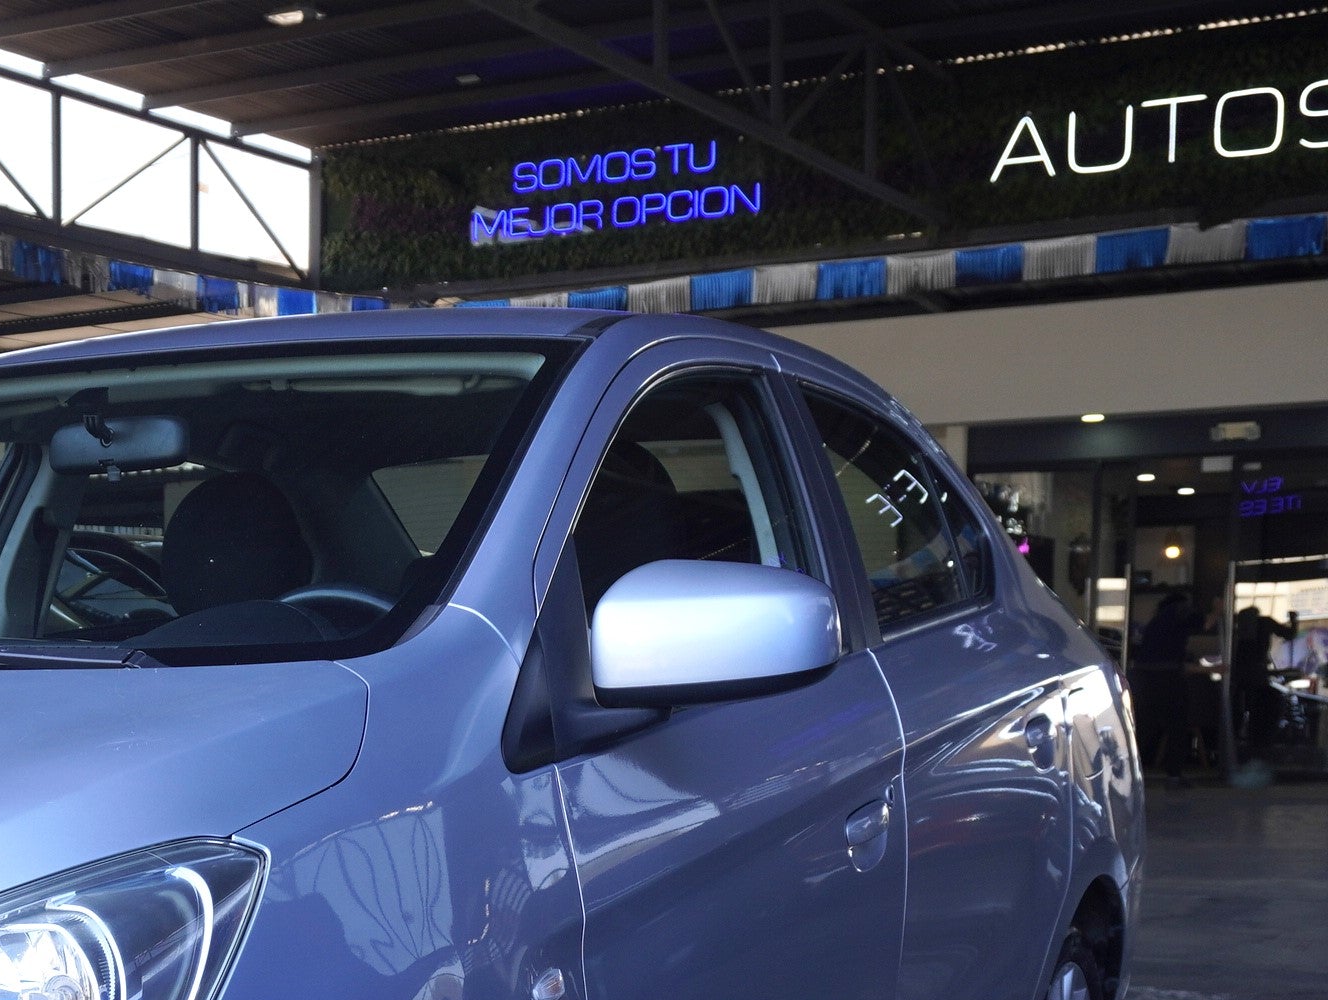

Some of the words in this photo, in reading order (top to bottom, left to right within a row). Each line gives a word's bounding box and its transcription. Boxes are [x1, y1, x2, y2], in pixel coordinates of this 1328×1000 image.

[511, 147, 658, 194] SOMOS
[662, 138, 718, 176] TU
[471, 199, 604, 243] MEJOR
[610, 181, 762, 229] OPCION
